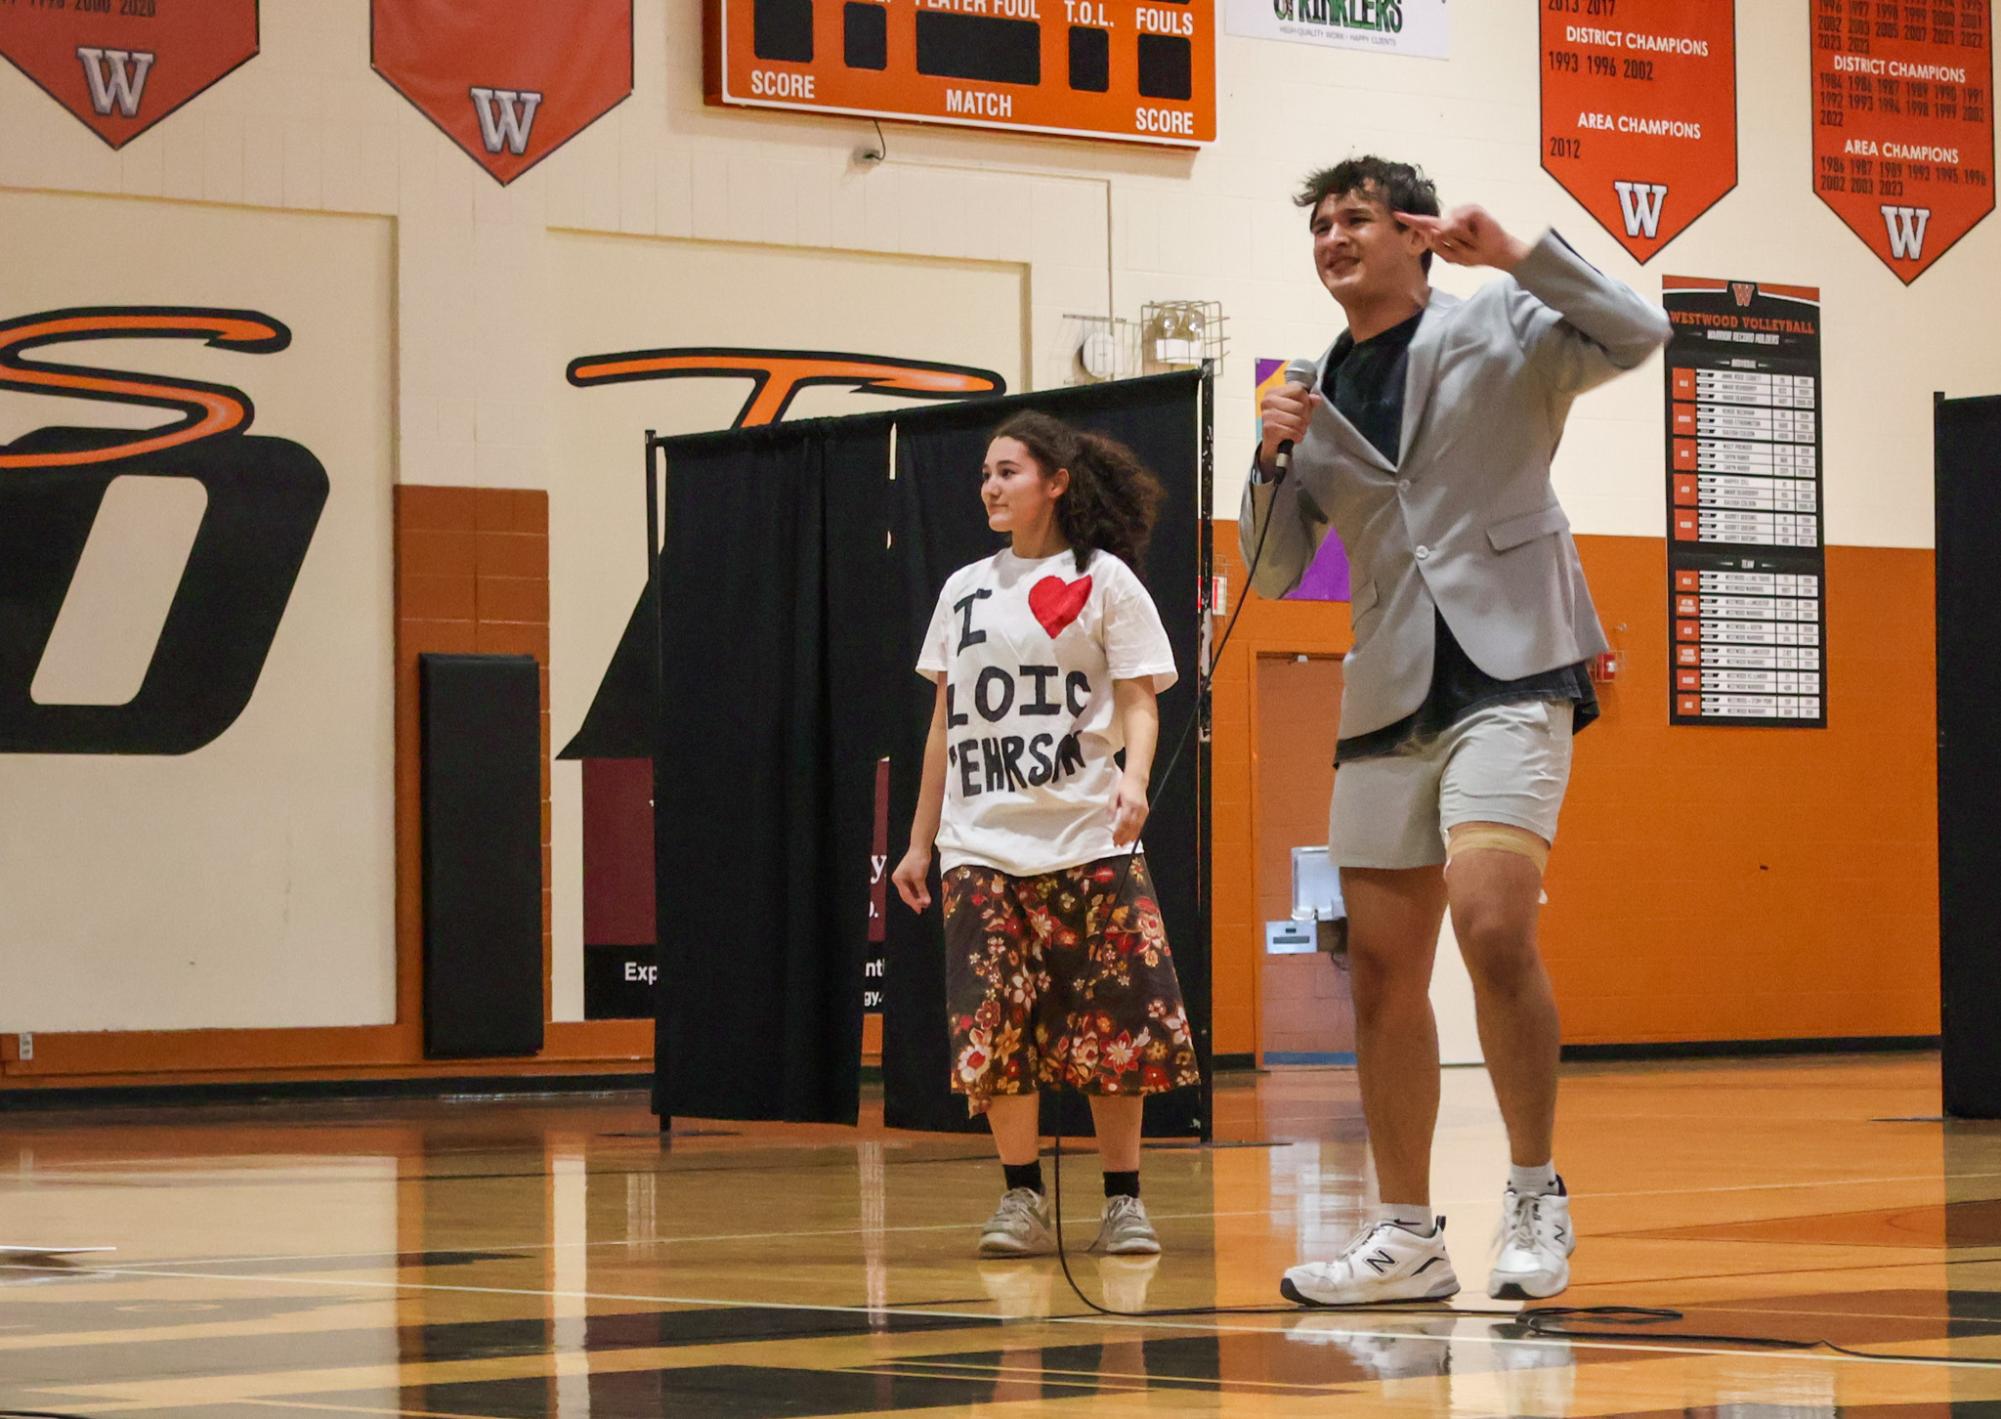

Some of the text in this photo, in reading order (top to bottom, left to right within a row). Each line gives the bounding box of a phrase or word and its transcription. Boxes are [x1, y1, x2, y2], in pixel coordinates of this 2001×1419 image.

[993, 0, 1041, 19] FOUL
[1063, 0, 1114, 28] T.O.L.
[1136, 7, 1193, 36] FOULS
[1566, 25, 1709, 57] DISTRICT CHAMPIONS
[1548, 51, 1654, 80] 1993 1996 2002
[1834, 55, 1966, 84] DISTRICT CHAMPIONS
[77, 47, 154, 117] W
[751, 70, 815, 98] SCORE
[946, 88, 1012, 118] MATCH
[470, 87, 543, 155] W
[1135, 107, 1194, 135] SCORE
[1577, 111, 1701, 140] AREA CHAMPIONS
[1549, 136, 1581, 159] 2012
[1844, 139, 1959, 164] AREA CHAMPIONS
[1612, 179, 1669, 240] W
[1879, 204, 1932, 261] W
[1668, 310, 1738, 328] WESTWOOD
[1742, 316, 1815, 335] VOLLEYBALL
[953, 588, 993, 658] I
[947, 665, 1092, 730] LOIC
[1366, 1250, 1396, 1273] N
